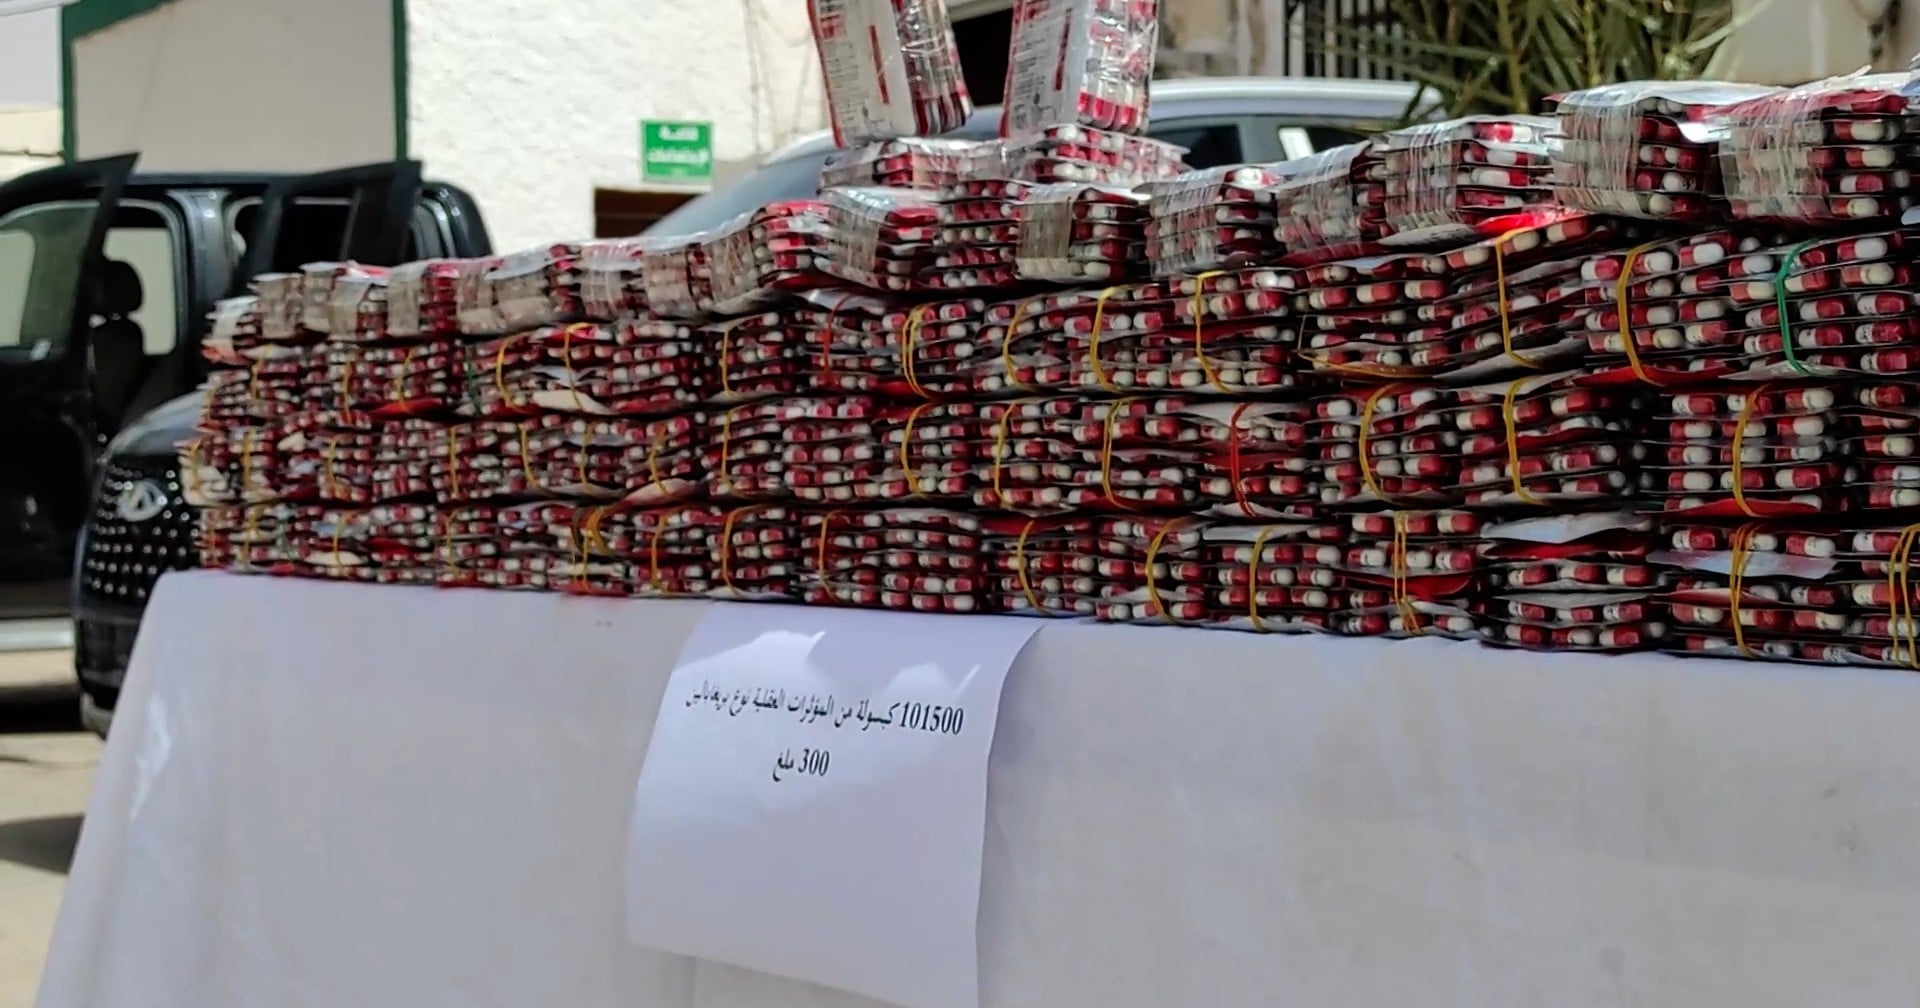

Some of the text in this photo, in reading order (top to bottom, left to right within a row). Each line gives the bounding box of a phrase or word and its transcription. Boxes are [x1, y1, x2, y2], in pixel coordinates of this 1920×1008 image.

[834, 707, 853, 729] من
[899, 701, 964, 735] 101500
[772, 747, 830, 783] 300 ملغ
